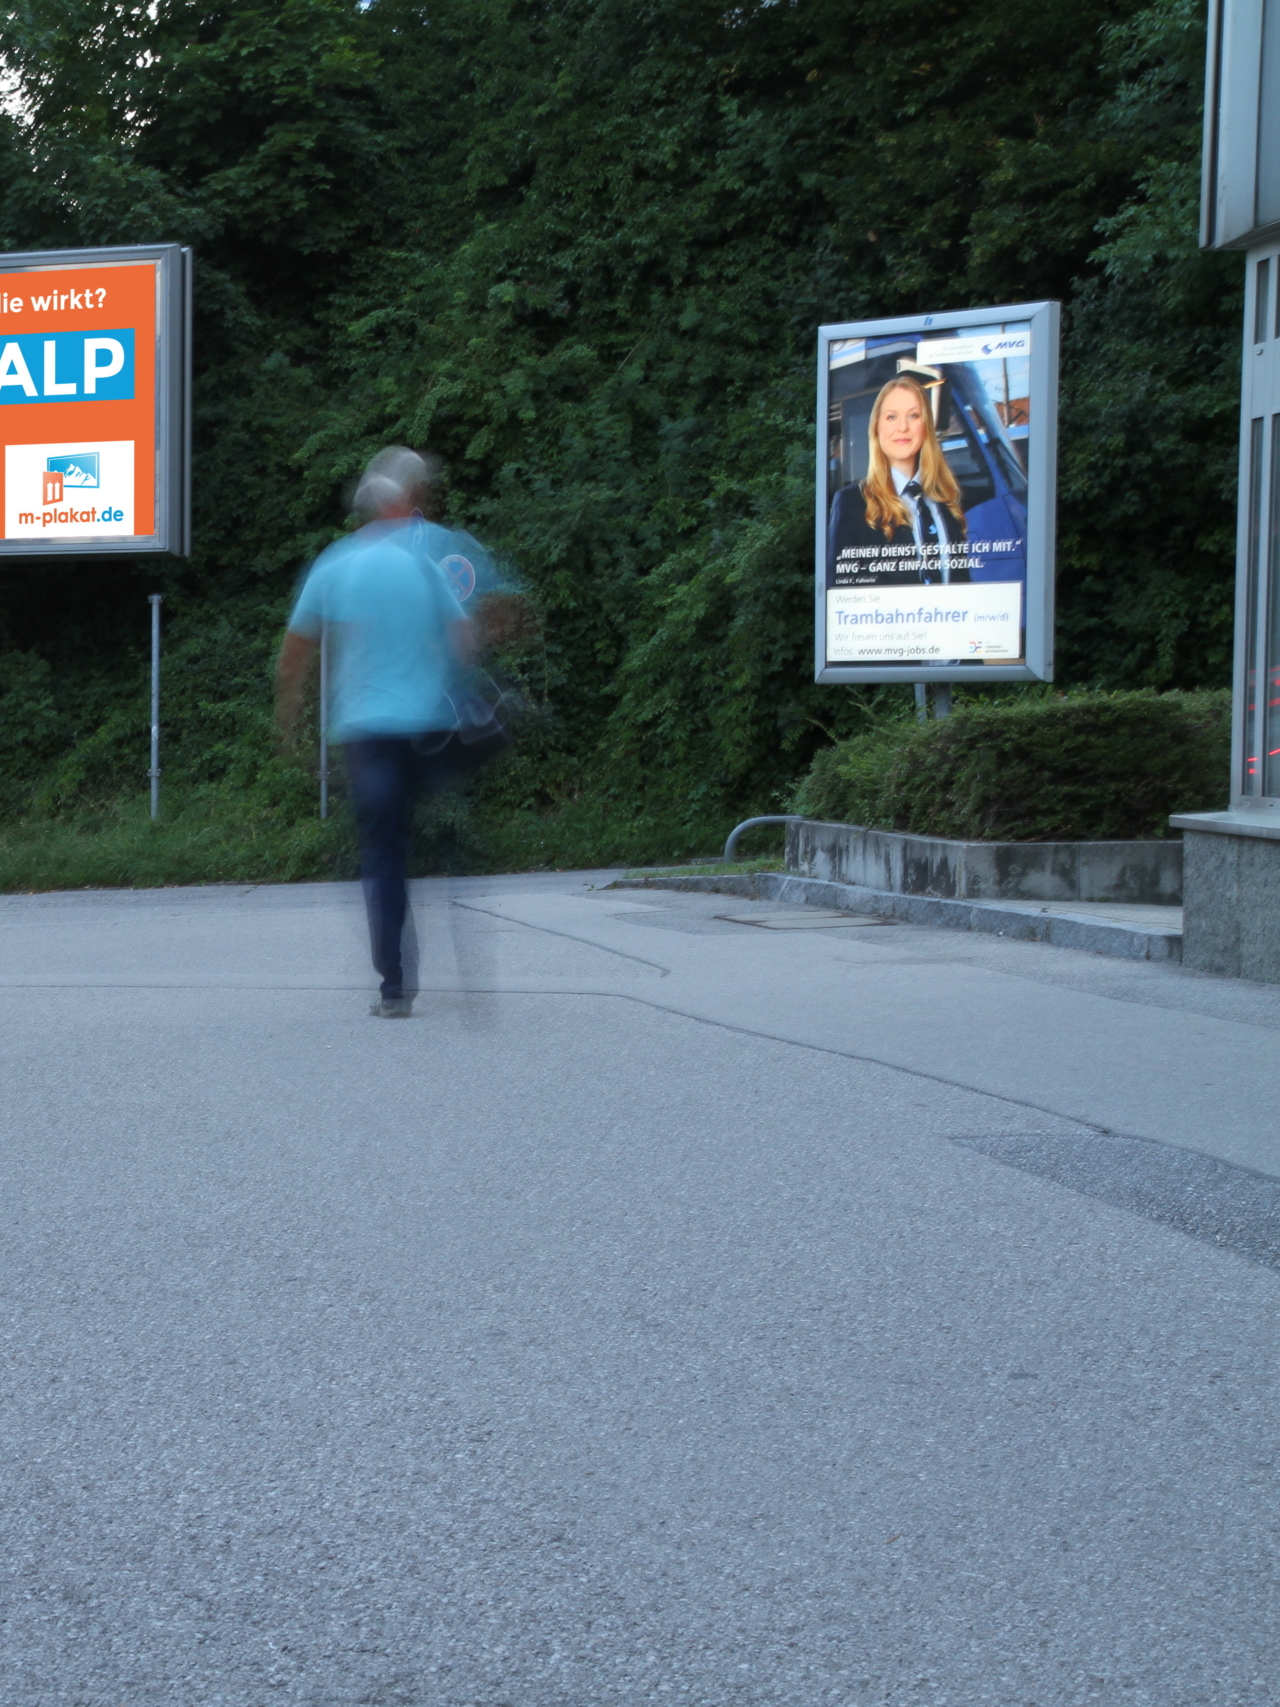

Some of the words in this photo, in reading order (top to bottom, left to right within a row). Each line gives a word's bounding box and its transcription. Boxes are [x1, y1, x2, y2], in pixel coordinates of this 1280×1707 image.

[30, 287, 107, 312] wirkt?
[994, 340, 1025, 350] MVG
[18, 506, 124, 528] m-plakat.de
[881, 545, 917, 558] DIENST
[919, 543, 969, 556] GESTALTE
[971, 541, 989, 554] ICH
[836, 563, 859, 574] MVG
[869, 561, 896, 573] GANZ
[898, 559, 941, 572] EINFACH
[944, 558, 985, 570] SOZIAL.
[835, 594, 866, 604] Werden
[868, 594, 880, 603] Sie
[835, 607, 969, 625] Trambahnfahrer
[973, 612, 1009, 623] (m/w/d)
[834, 633, 850, 642] Wir
[851, 631, 877, 642] freuen
[879, 632, 894, 641] uns
[896, 631, 910, 641] auf
[911, 630, 927, 641] Sie!
[833, 647, 855, 656] Infos:
[857, 645, 940, 657] www.mvg-jobs.de
